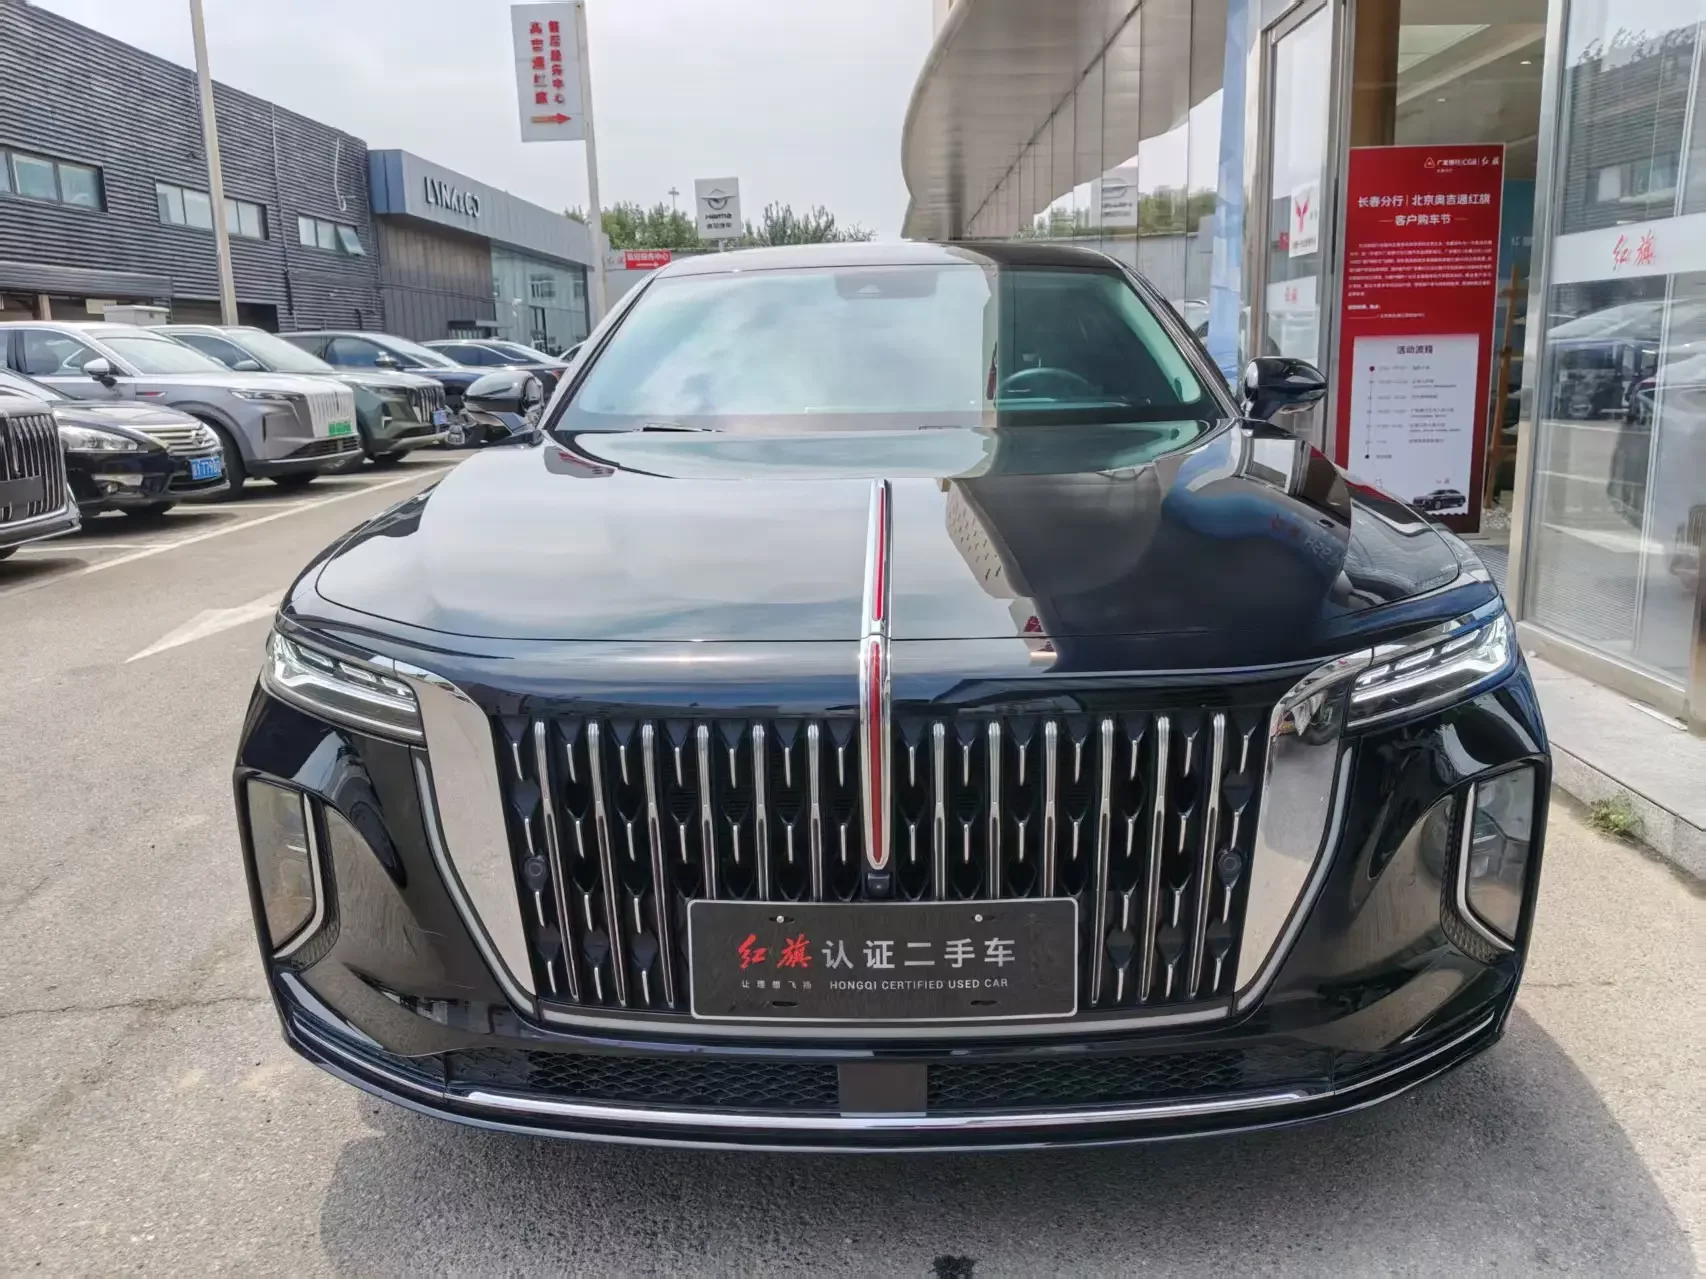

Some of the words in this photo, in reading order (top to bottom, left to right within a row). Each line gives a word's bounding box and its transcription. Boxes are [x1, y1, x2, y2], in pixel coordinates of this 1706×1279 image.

[1395, 213, 1451, 226] 客户购车节
[829, 980, 877, 990] HONGQI
[881, 980, 944, 990] CERTIFIED
[948, 979, 980, 989] USED
[984, 978, 1009, 988] CAR
